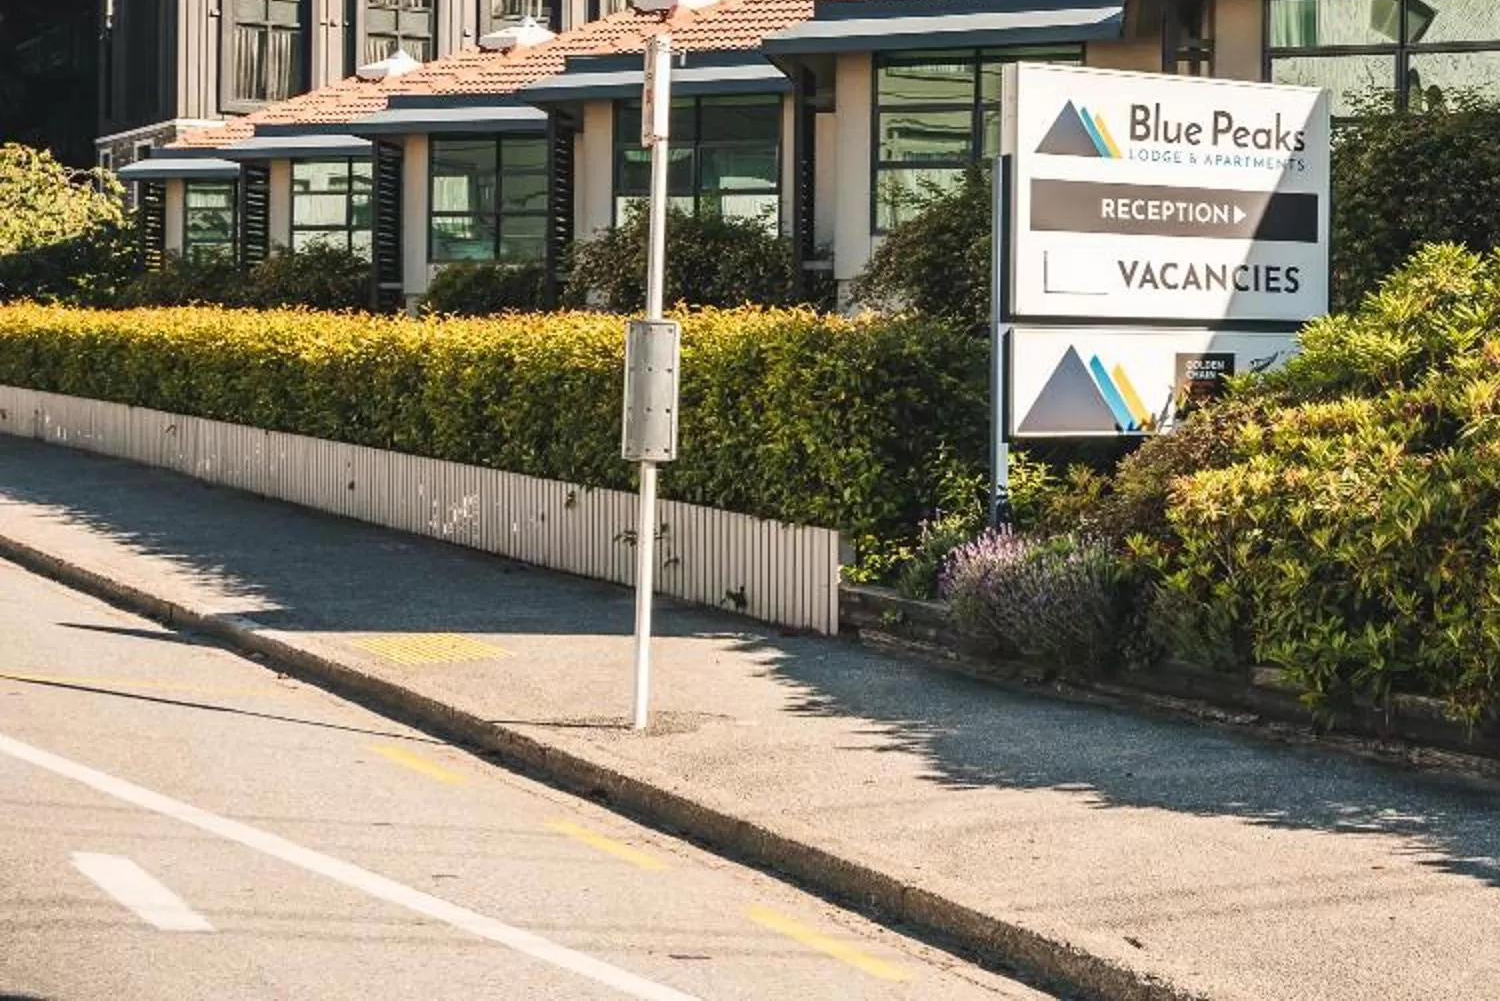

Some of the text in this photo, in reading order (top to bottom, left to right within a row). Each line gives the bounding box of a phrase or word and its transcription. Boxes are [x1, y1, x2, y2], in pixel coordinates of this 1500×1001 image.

[1130, 103, 1305, 151] Blue Peaks
[1129, 149, 1305, 171] LODGE & APARTMENTS
[1101, 199, 1229, 223] RECEPTION
[1118, 260, 1300, 293] VACANCIES
